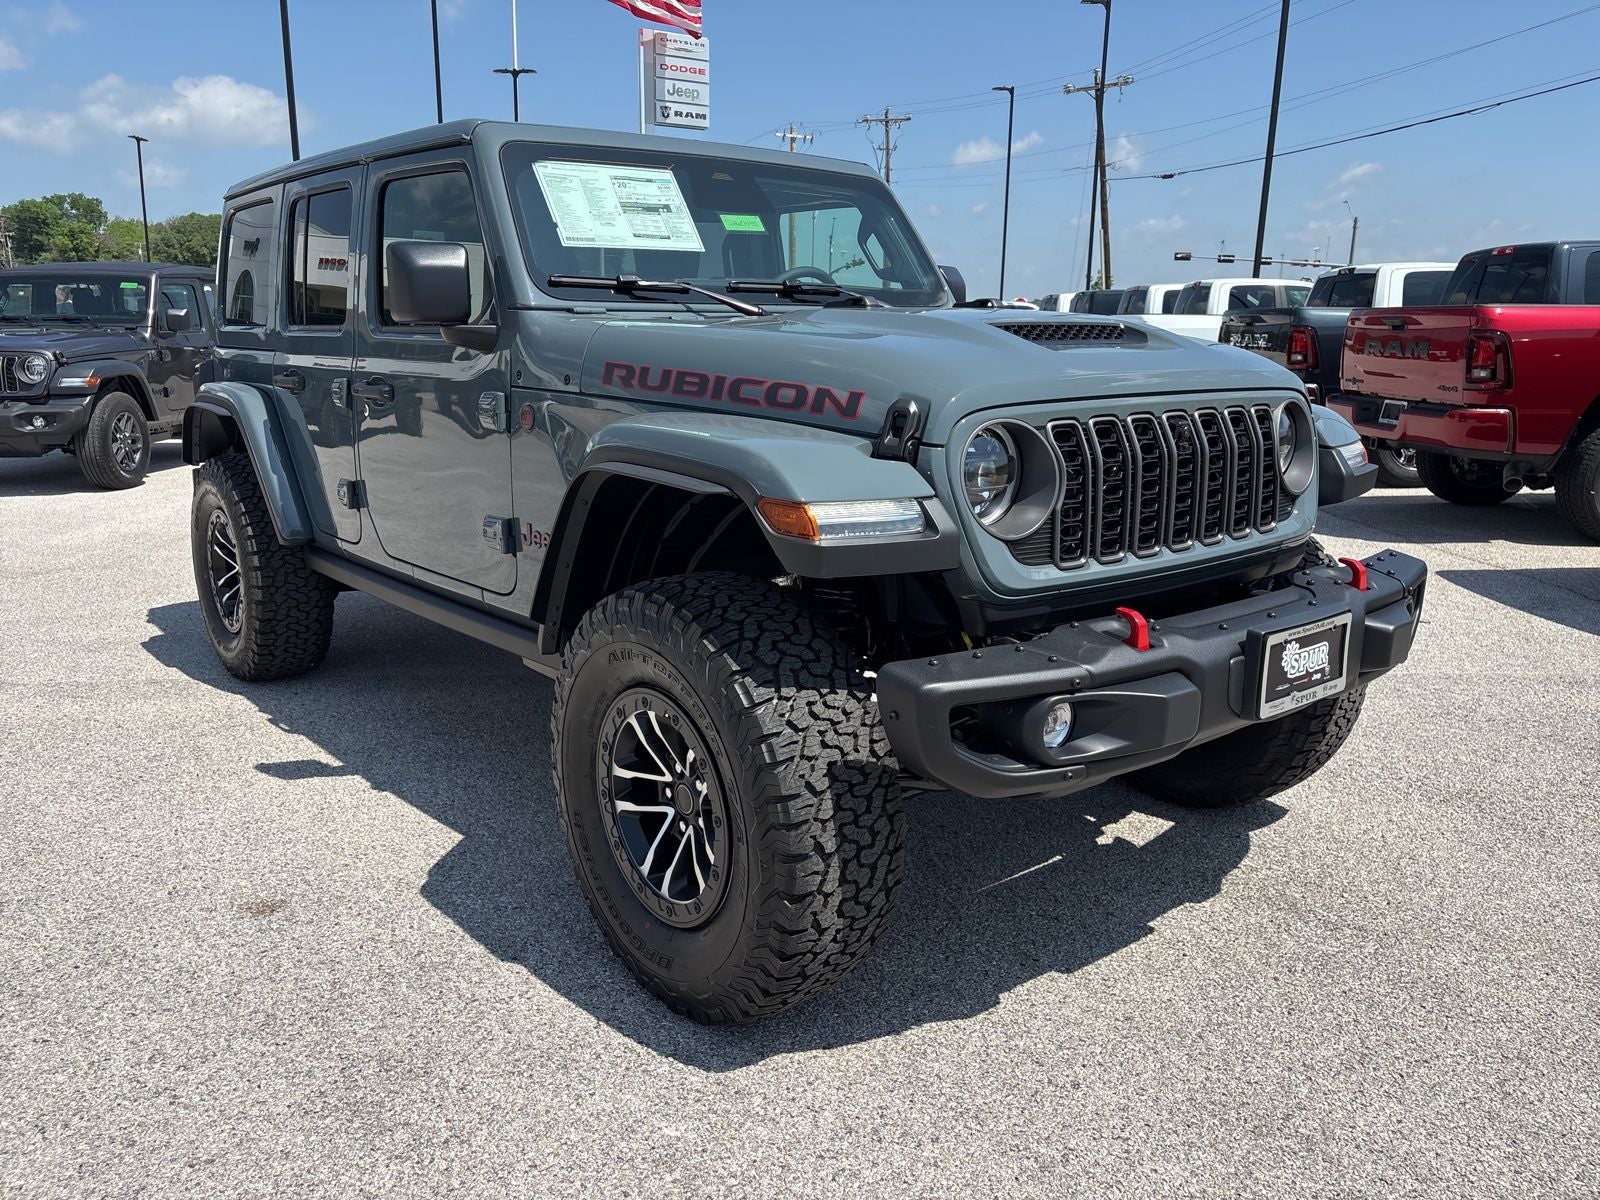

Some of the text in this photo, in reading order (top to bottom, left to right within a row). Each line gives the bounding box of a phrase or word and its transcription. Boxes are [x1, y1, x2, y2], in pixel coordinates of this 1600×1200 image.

[660, 37, 705, 48] CHRYSLER
[660, 63, 706, 75] DODGE
[667, 83, 700, 101] Jeep
[674, 110, 707, 120] RAM
[1230, 333, 1269, 347] RAM
[1364, 340, 1430, 358] RAM
[602, 360, 866, 421] RUBICON
[521, 522, 551, 549] Jee
[1288, 643, 1329, 676] SPUR
[1295, 690, 1317, 706] SPUR
